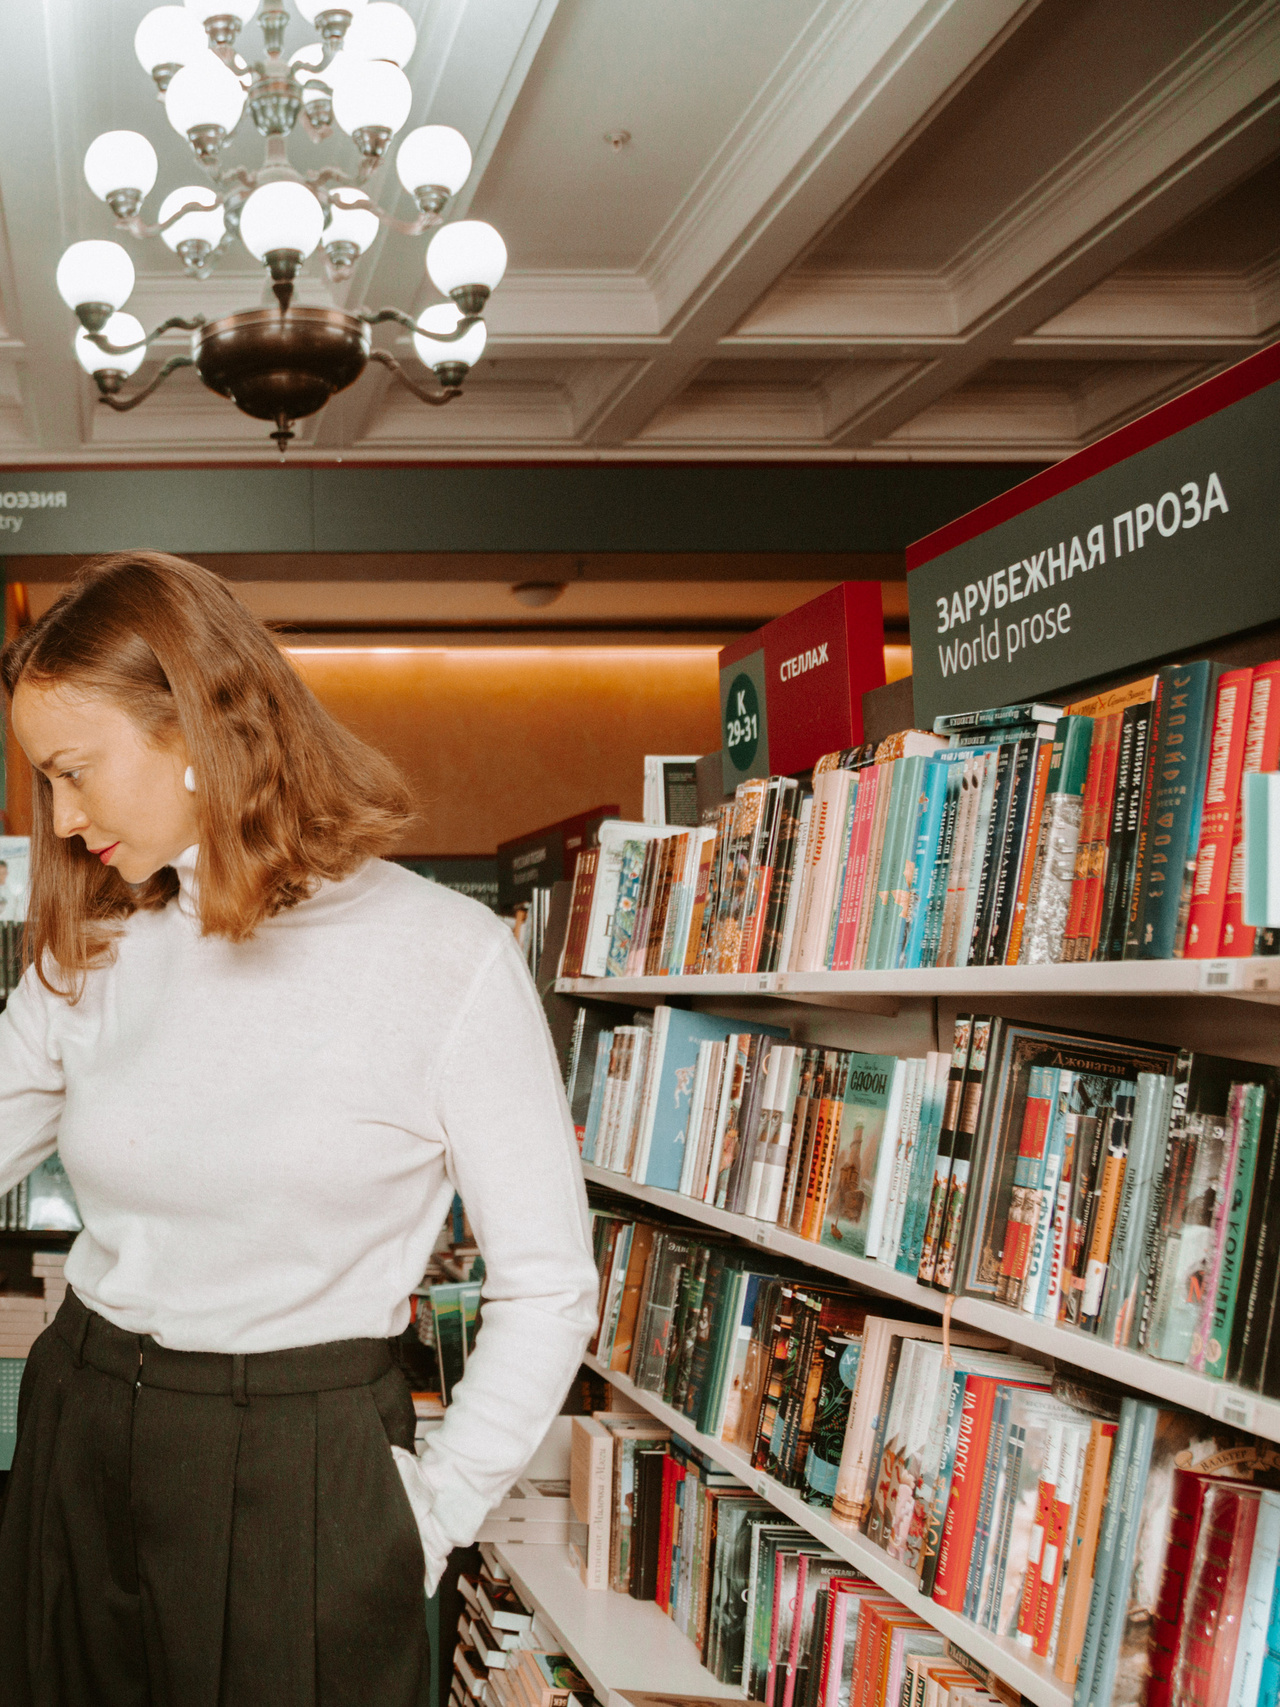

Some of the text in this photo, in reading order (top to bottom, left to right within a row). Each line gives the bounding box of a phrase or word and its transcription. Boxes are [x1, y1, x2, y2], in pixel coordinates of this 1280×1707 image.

[936, 472, 1229, 634] ЗАРУБЕЖНАЯ ПРОЗА
[780, 642, 829, 683] СТЕЛЛАЖ
[938, 602, 1071, 678] World prose
[727, 713, 757, 748] 29-31
[1141, 679, 1164, 826] РАЗГОВОРЫ С ДРУЗЬЯМИ
[1113, 722, 1133, 832] ПЯТЬ ЖИЗНЕЙ
[1126, 718, 1147, 831] ПЯТЬ ЖИЗНЕЙ
[1130, 831, 1148, 922] САЛЛИ РУНИ
[850, 1070, 888, 1096] САФОН
[1051, 1050, 1126, 1076] Джонатан
[1027, 1181, 1052, 1277] СВИФТ
[1043, 1201, 1069, 1296] СВИФТ
[1115, 1166, 1137, 1255] ПРИМИТИВНЫЕ
[595, 1447, 606, 1480] Мэгги
[937, 1381, 961, 1471] Клэр Сибер
[951, 1390, 978, 1483] НА ВОЛОСКЕ
[1202, 1447, 1248, 1473] ВАЛЬТЕР
[594, 1483, 604, 1530] Милочка
[746, 1518, 769, 1527] ХОСЕ
[820, 1566, 856, 1577] БЕСТСЕЛЛЕР
